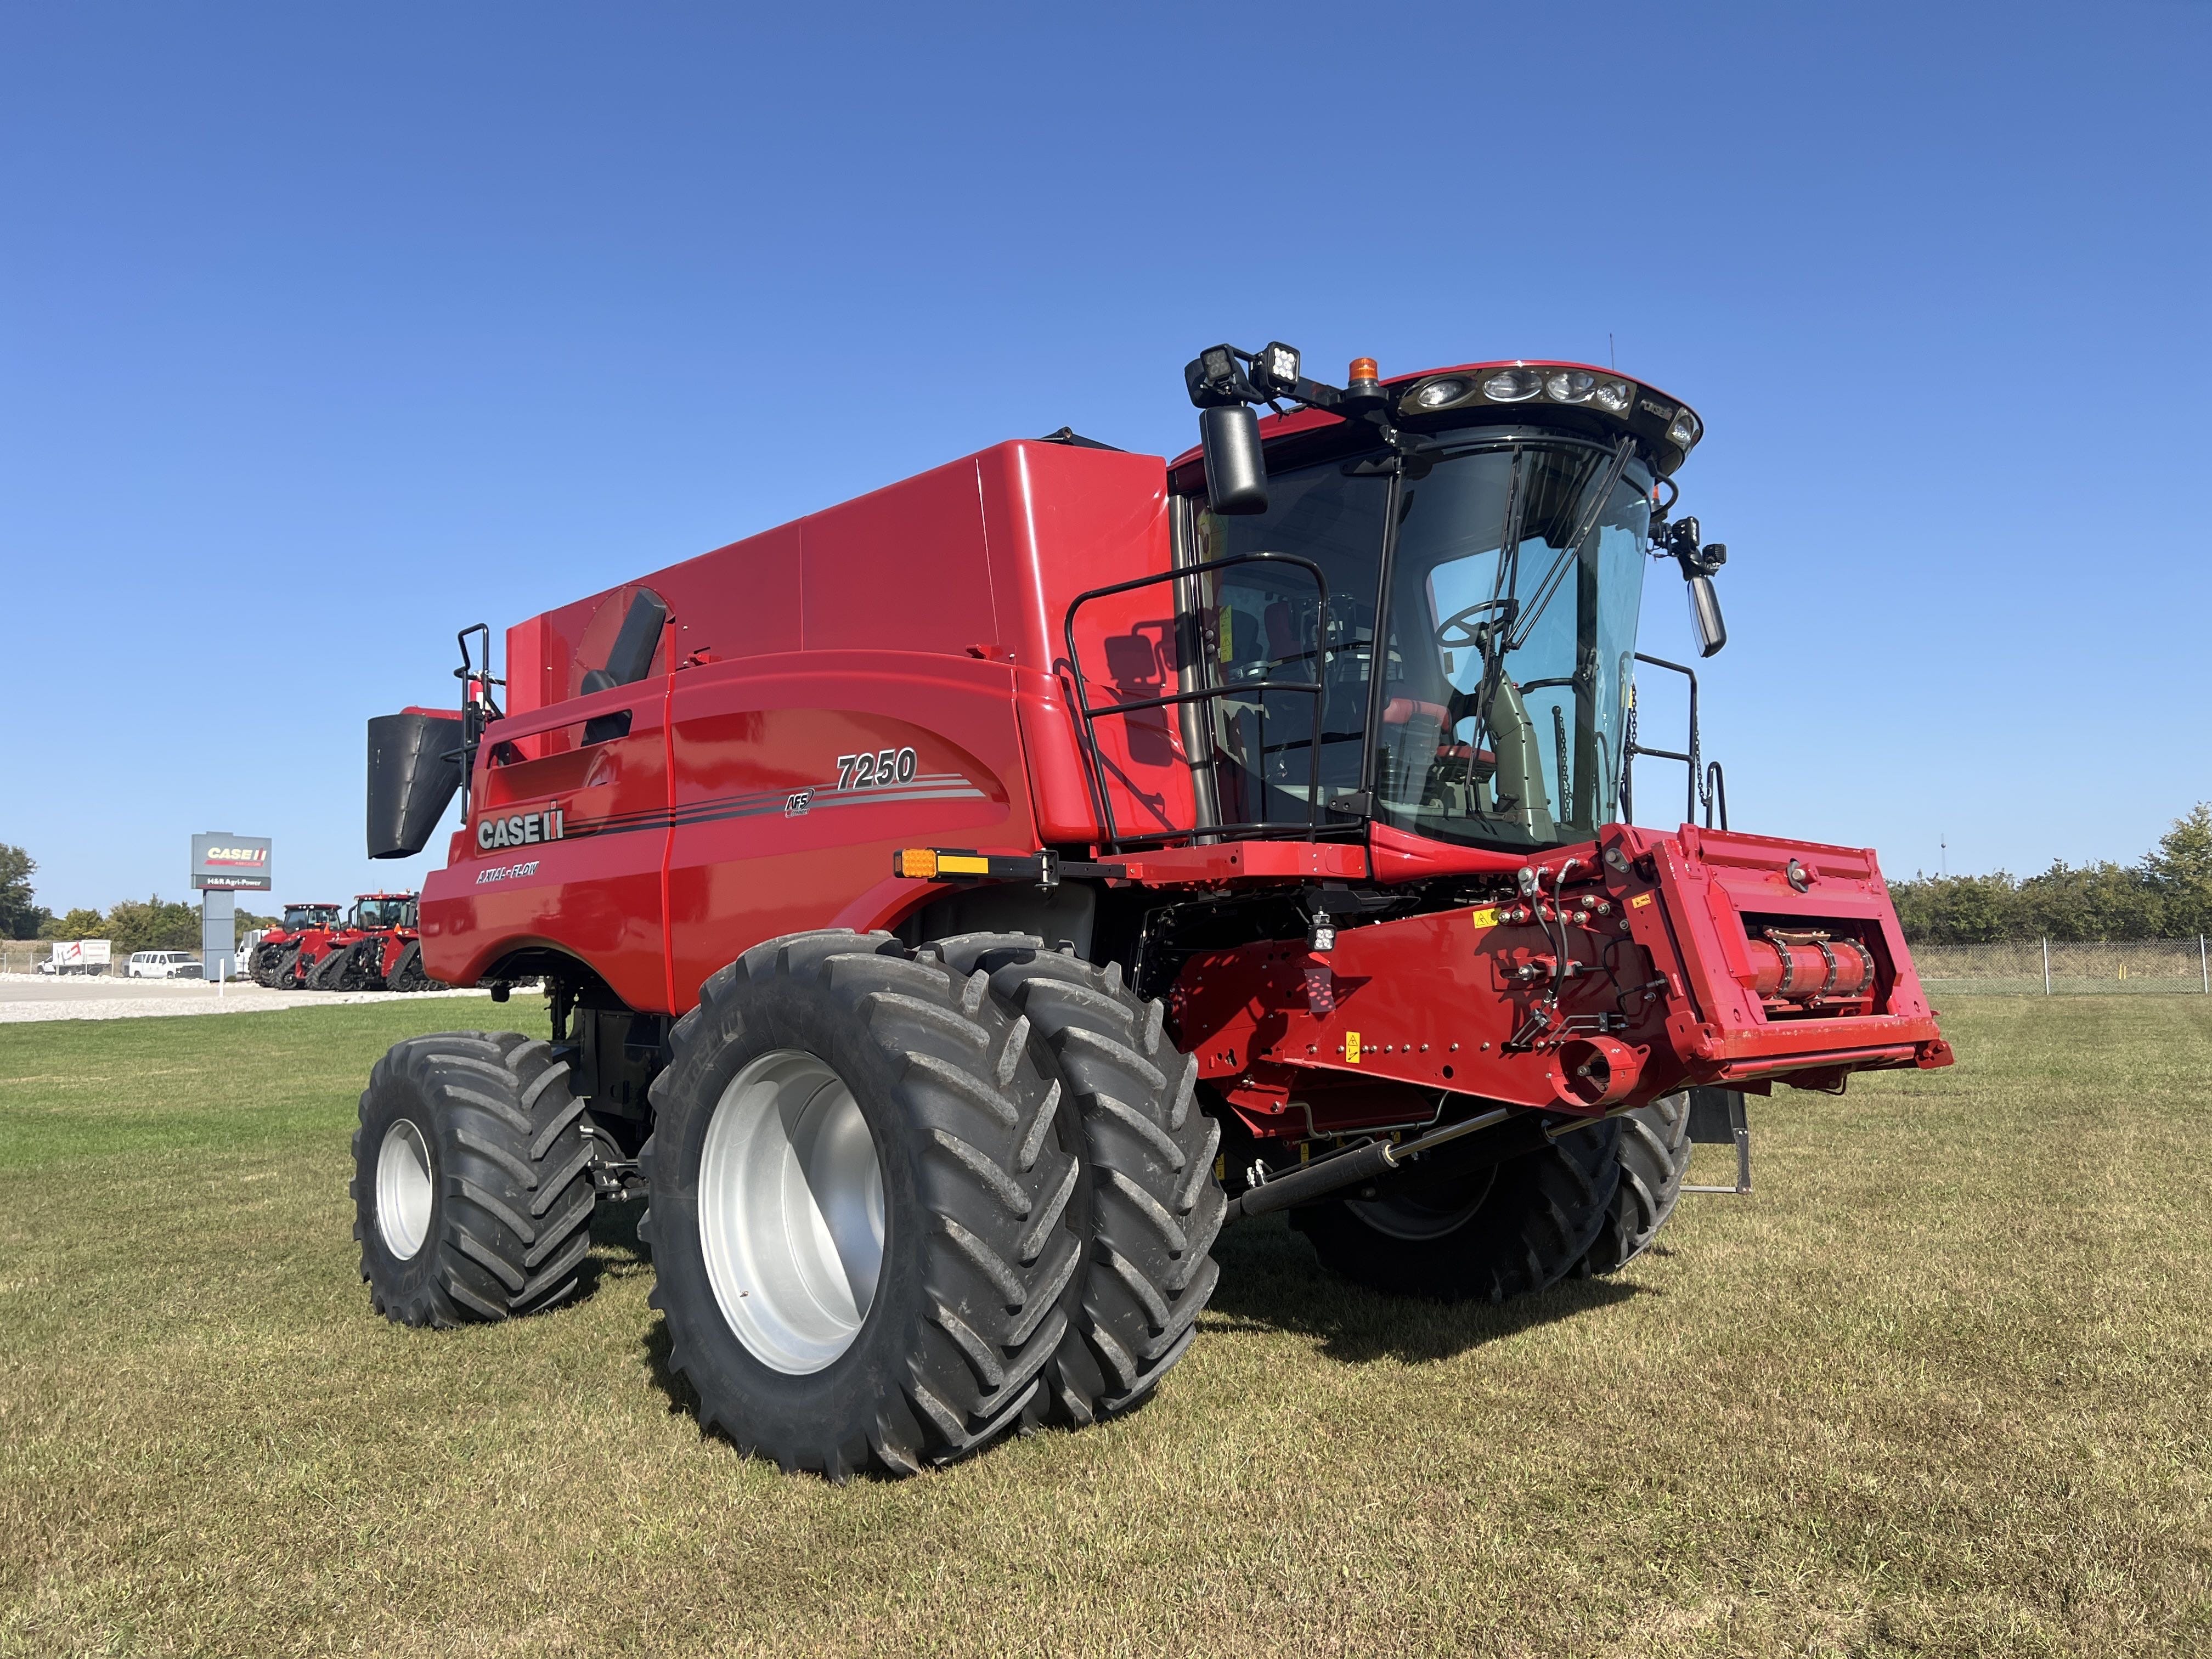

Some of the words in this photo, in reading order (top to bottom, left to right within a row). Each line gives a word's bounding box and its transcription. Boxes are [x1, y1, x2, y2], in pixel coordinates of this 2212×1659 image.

[837, 747, 917, 791] 7250
[785, 793, 809, 811] AFS
[478, 814, 540, 849] CASE
[208, 847, 253, 860] CASE
[476, 860, 540, 884] AXIAL-FLOW
